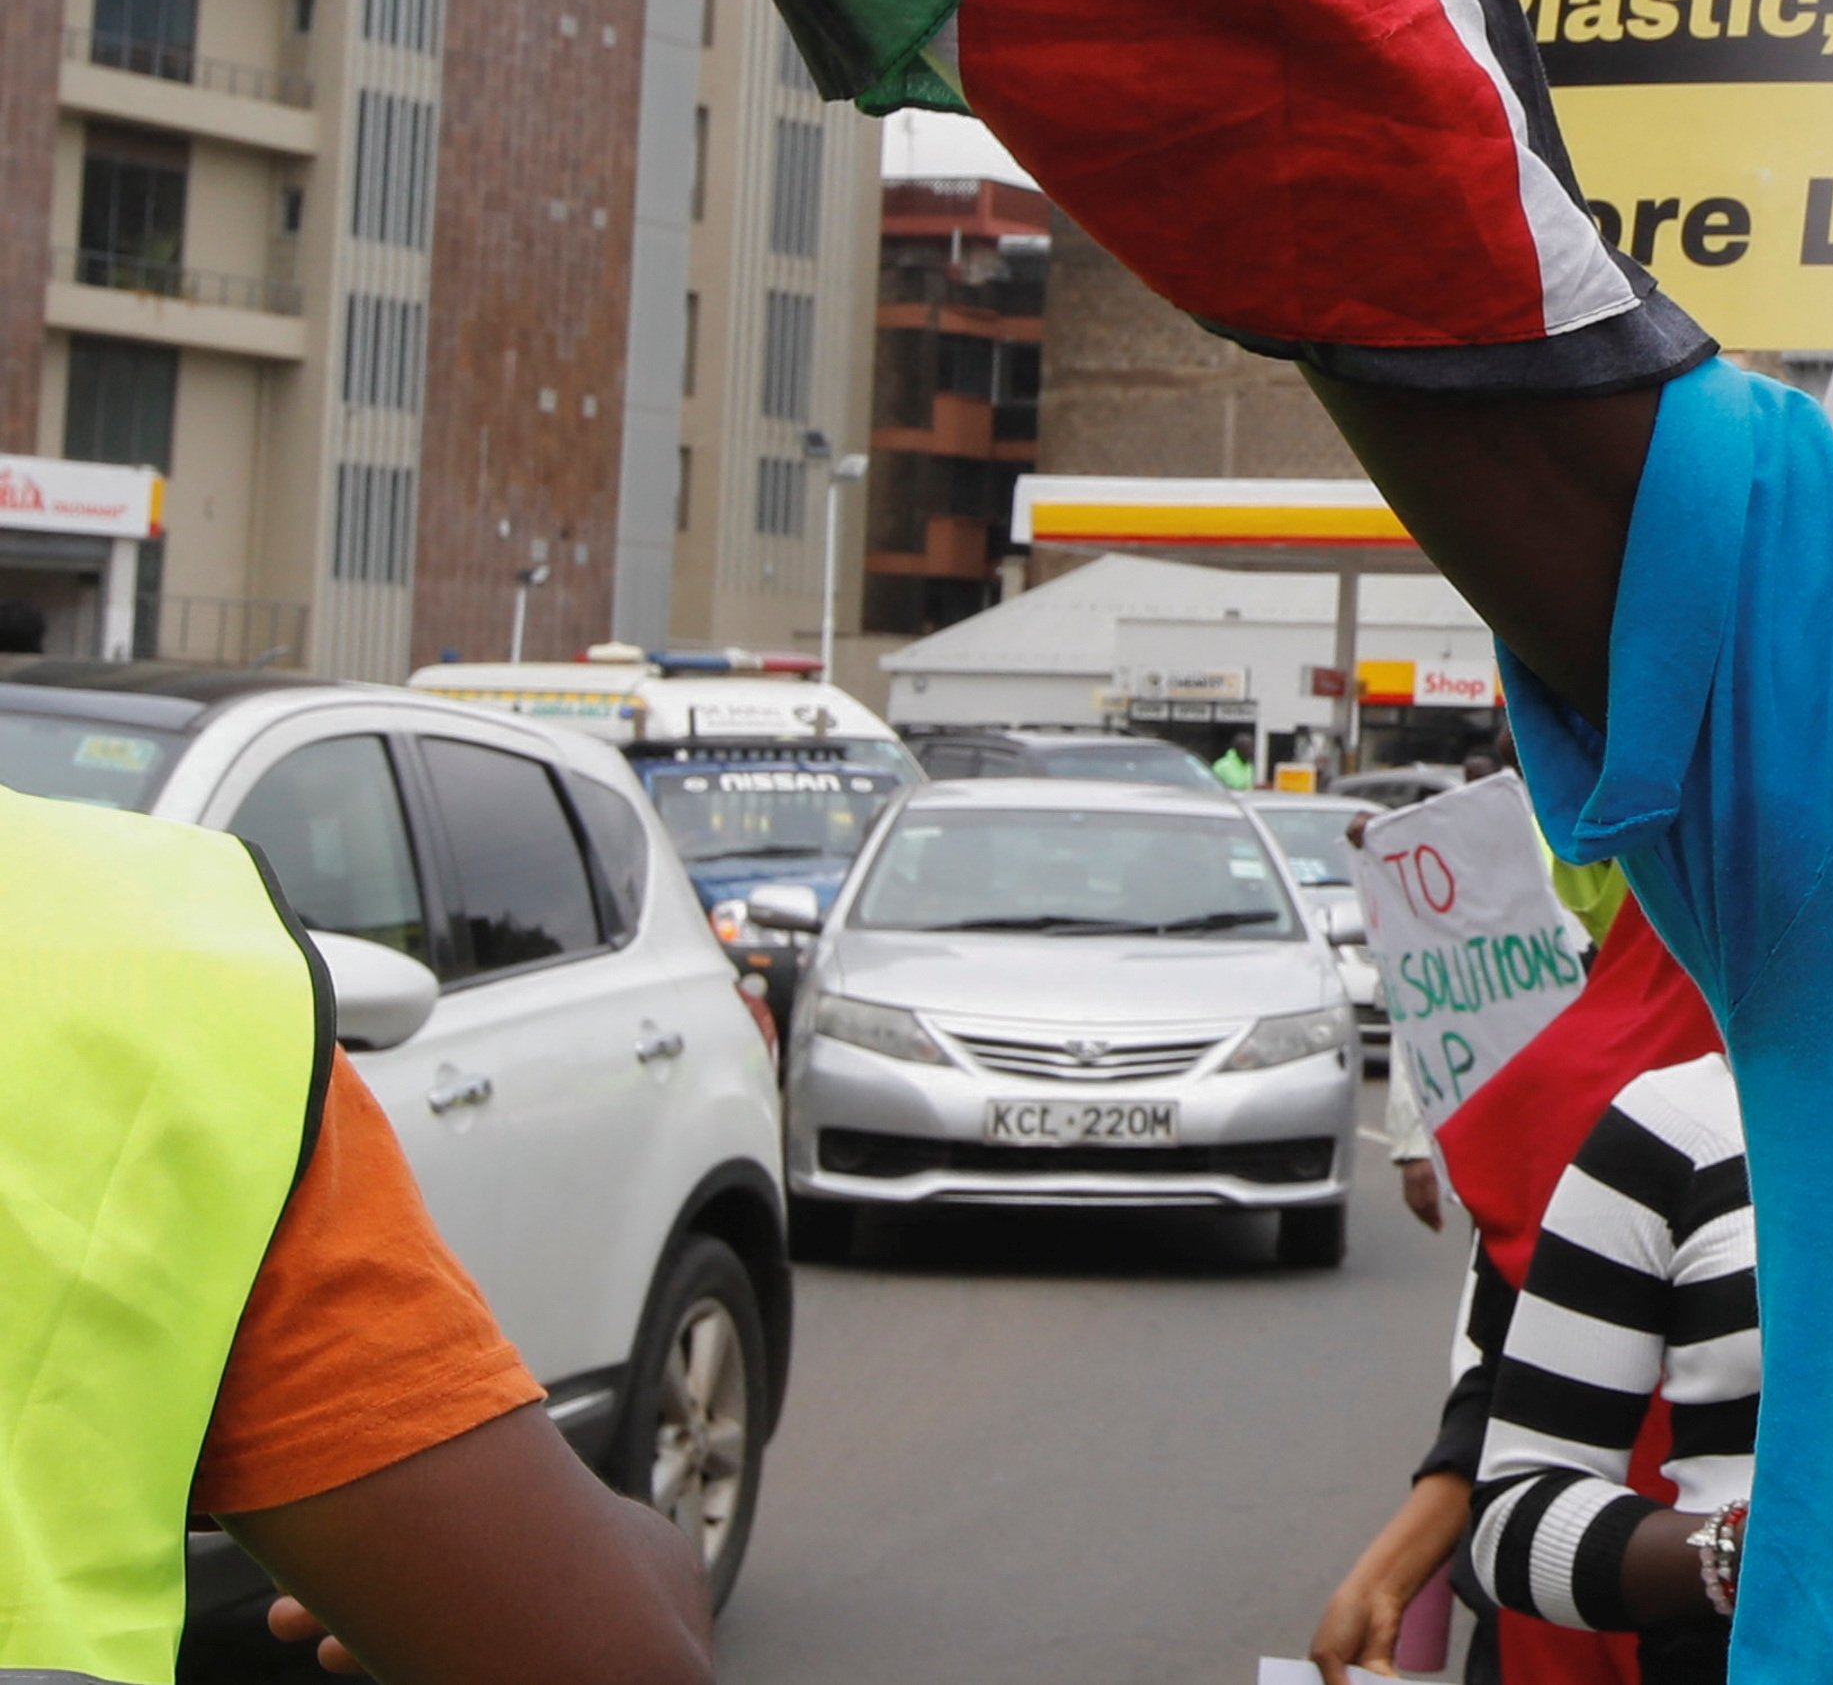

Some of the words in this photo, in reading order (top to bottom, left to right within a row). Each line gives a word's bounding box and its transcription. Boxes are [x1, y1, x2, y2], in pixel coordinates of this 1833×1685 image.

[1424, 670, 1486, 701] Shop
[718, 772, 842, 793] NISSAN
[1383, 844, 1455, 916] TO
[1401, 924, 1580, 1019] SOLUTIONS
